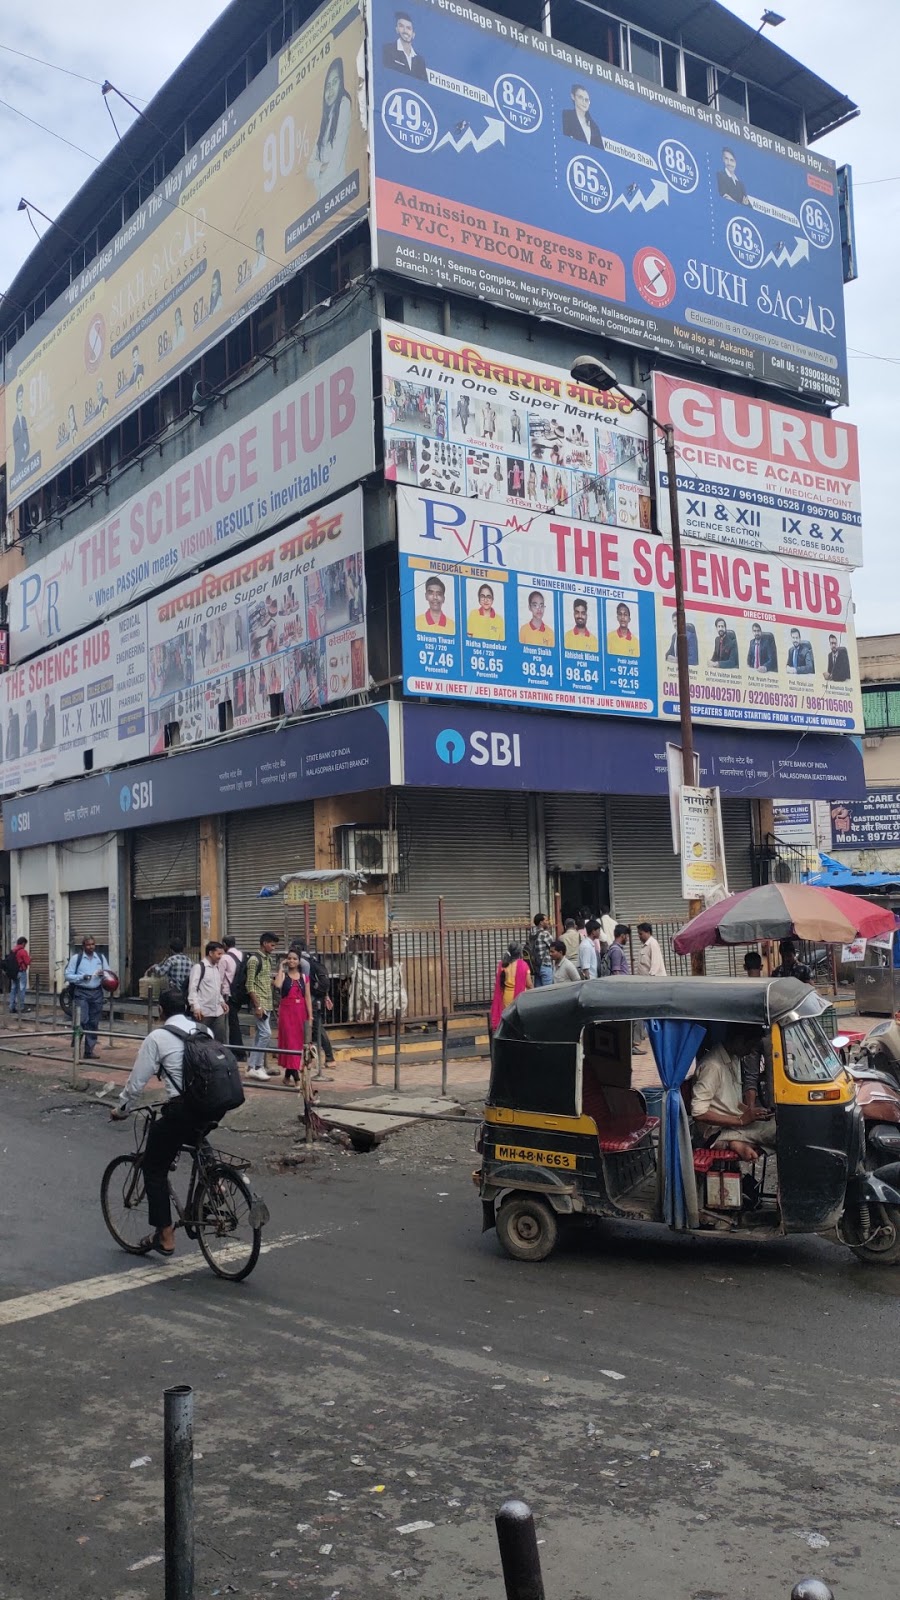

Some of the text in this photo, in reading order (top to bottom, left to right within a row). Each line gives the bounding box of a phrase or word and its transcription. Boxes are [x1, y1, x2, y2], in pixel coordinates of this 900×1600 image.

[430, 72, 461, 94] Prinson
[431, 0, 829, 174] ercentage To Har Koi Lata Hey But Aisa Improvement Sirf Sukh Sagar He Deta Hey...
[502, 81, 537, 115] 84%
[222, 134, 246, 162] Result
[258, 84, 294, 122] TYBCom
[296, 42, 332, 88] 2017-18
[388, 95, 432, 136] 49%
[665, 146, 694, 177] 88%
[573, 162, 608, 198] 65%
[80, 158, 198, 292] Advertise Honestly The Way we
[287, 181, 357, 245] HEMLATA SAXENA
[394, 192, 613, 271] Admission In Progress For
[402, 212, 609, 288] FYJC, FYBCOM & FYBAF
[424, 253, 644, 329] D/41, Seema Complex, Near Flyover Bridge, Nallasopara
[684, 258, 748, 307] SUKH
[757, 284, 836, 338] SAGAR
[396, 258, 744, 368] Branch 1st, Floor, Gokul Tower, Next To Computech Computer Academy, Nallasopara
[673, 326, 716, 348] Now also at
[690, 312, 767, 346] Education Oxygen
[771, 356, 795, 372] Call Us
[407, 364, 619, 427] All in One Super Market
[800, 378, 841, 398] 7219610005
[669, 388, 850, 470] GURU
[78, 366, 356, 588] THE SCIENCE HUB
[765, 466, 852, 496] ACADEMY
[686, 498, 761, 527] XI & XII
[698, 482, 840, 520] 28532 961988 0528 996790
[785, 486, 853, 509] MEDICAL POINT
[686, 518, 760, 538] SCIENCE SECTION
[782, 517, 844, 544] IX & X
[116, 498, 268, 597] PASSION meets RESULT is
[778, 546, 818, 560] PHARMACY
[801, 540, 845, 554] CBSE BOARD
[430, 561, 488, 578] MEDICAL NEET
[550, 523, 620, 581] THE
[782, 568, 842, 616] HUB
[177, 556, 316, 633] All One Super Market
[532, 578, 625, 599] ENGINEERING JEE/MHT-CET
[744, 610, 777, 622] DIRECTORS
[6, 668, 25, 703] THE
[29, 644, 78, 694] SCIENCE
[83, 630, 110, 670] HUB
[419, 651, 455, 668] 97.46
[470, 656, 504, 674] 96.65
[522, 662, 554, 678] 98.94
[566, 667, 599, 683] 98.64
[618, 666, 639, 676] 97.45
[415, 680, 648, 711] NEW (NEET JEE) BATCH STARTING FROM 14TH JUNE ONWARDS
[618, 678, 639, 689] 92.15
[690, 684, 741, 703] 9970402570
[748, 690, 798, 708] 9220697337
[724, 708, 847, 727] BATCH STARTING FROM ONWARDS
[470, 730, 521, 768] SBI
[132, 779, 153, 810] SBI
[18, 812, 31, 832] SBI
[836, 834, 864, 843] Mob.:
